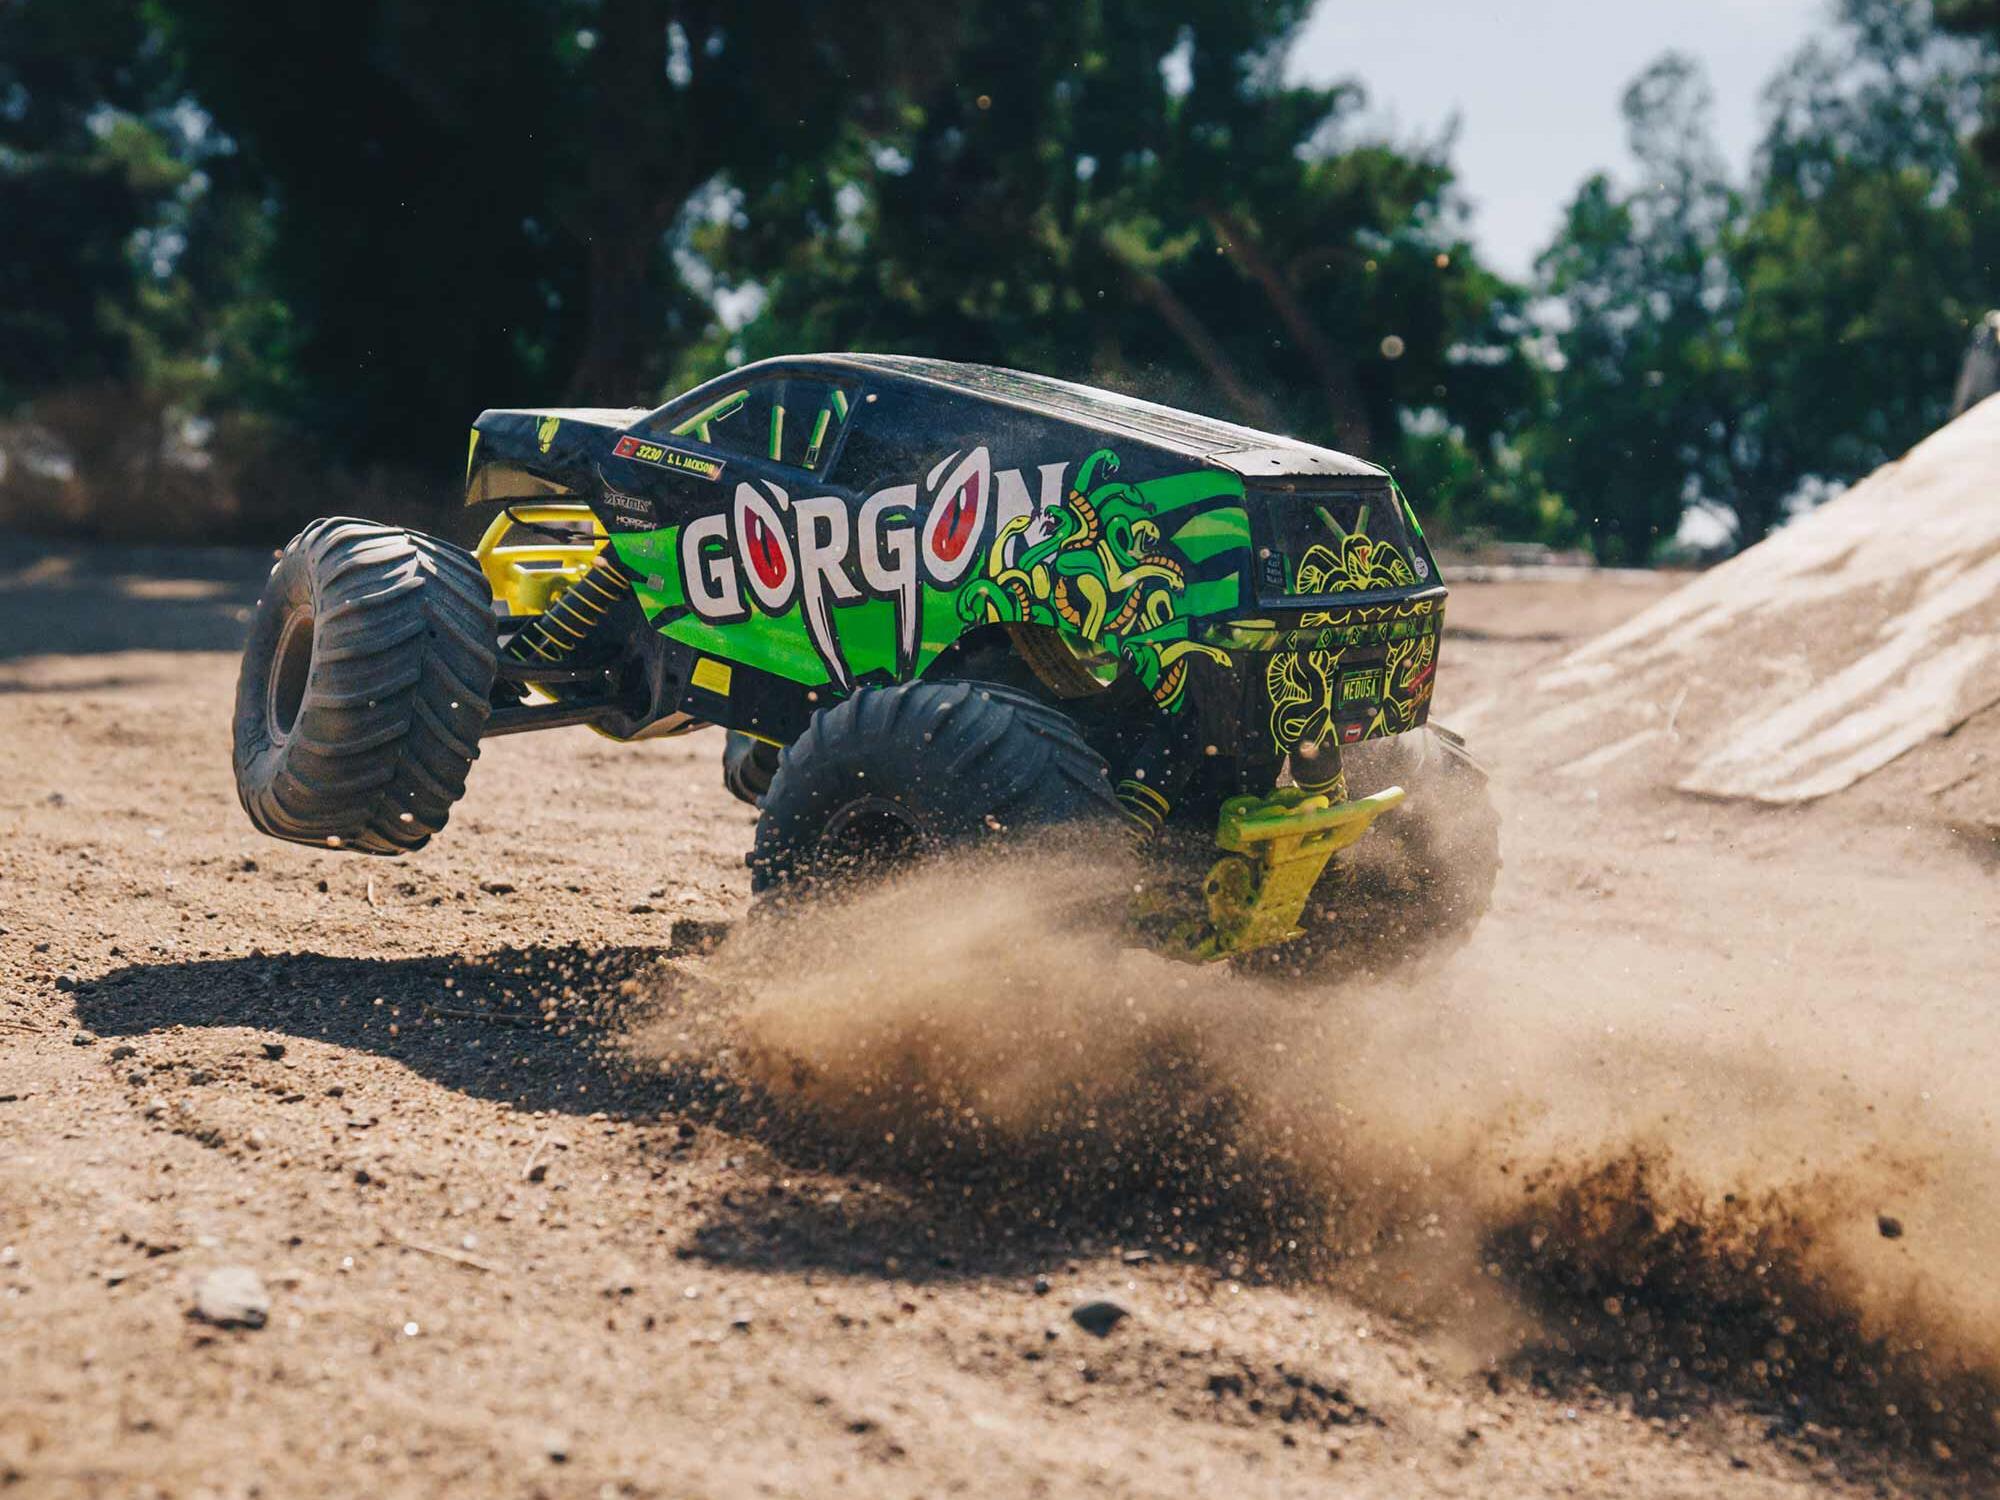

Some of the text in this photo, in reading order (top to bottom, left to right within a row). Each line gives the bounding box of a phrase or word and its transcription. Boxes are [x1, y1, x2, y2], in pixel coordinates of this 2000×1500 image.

[636, 444, 663, 461] 3230
[683, 456, 717, 476] JACKSON
[682, 446, 1070, 691] GORGON
[1343, 678, 1377, 701] MEDUSA
